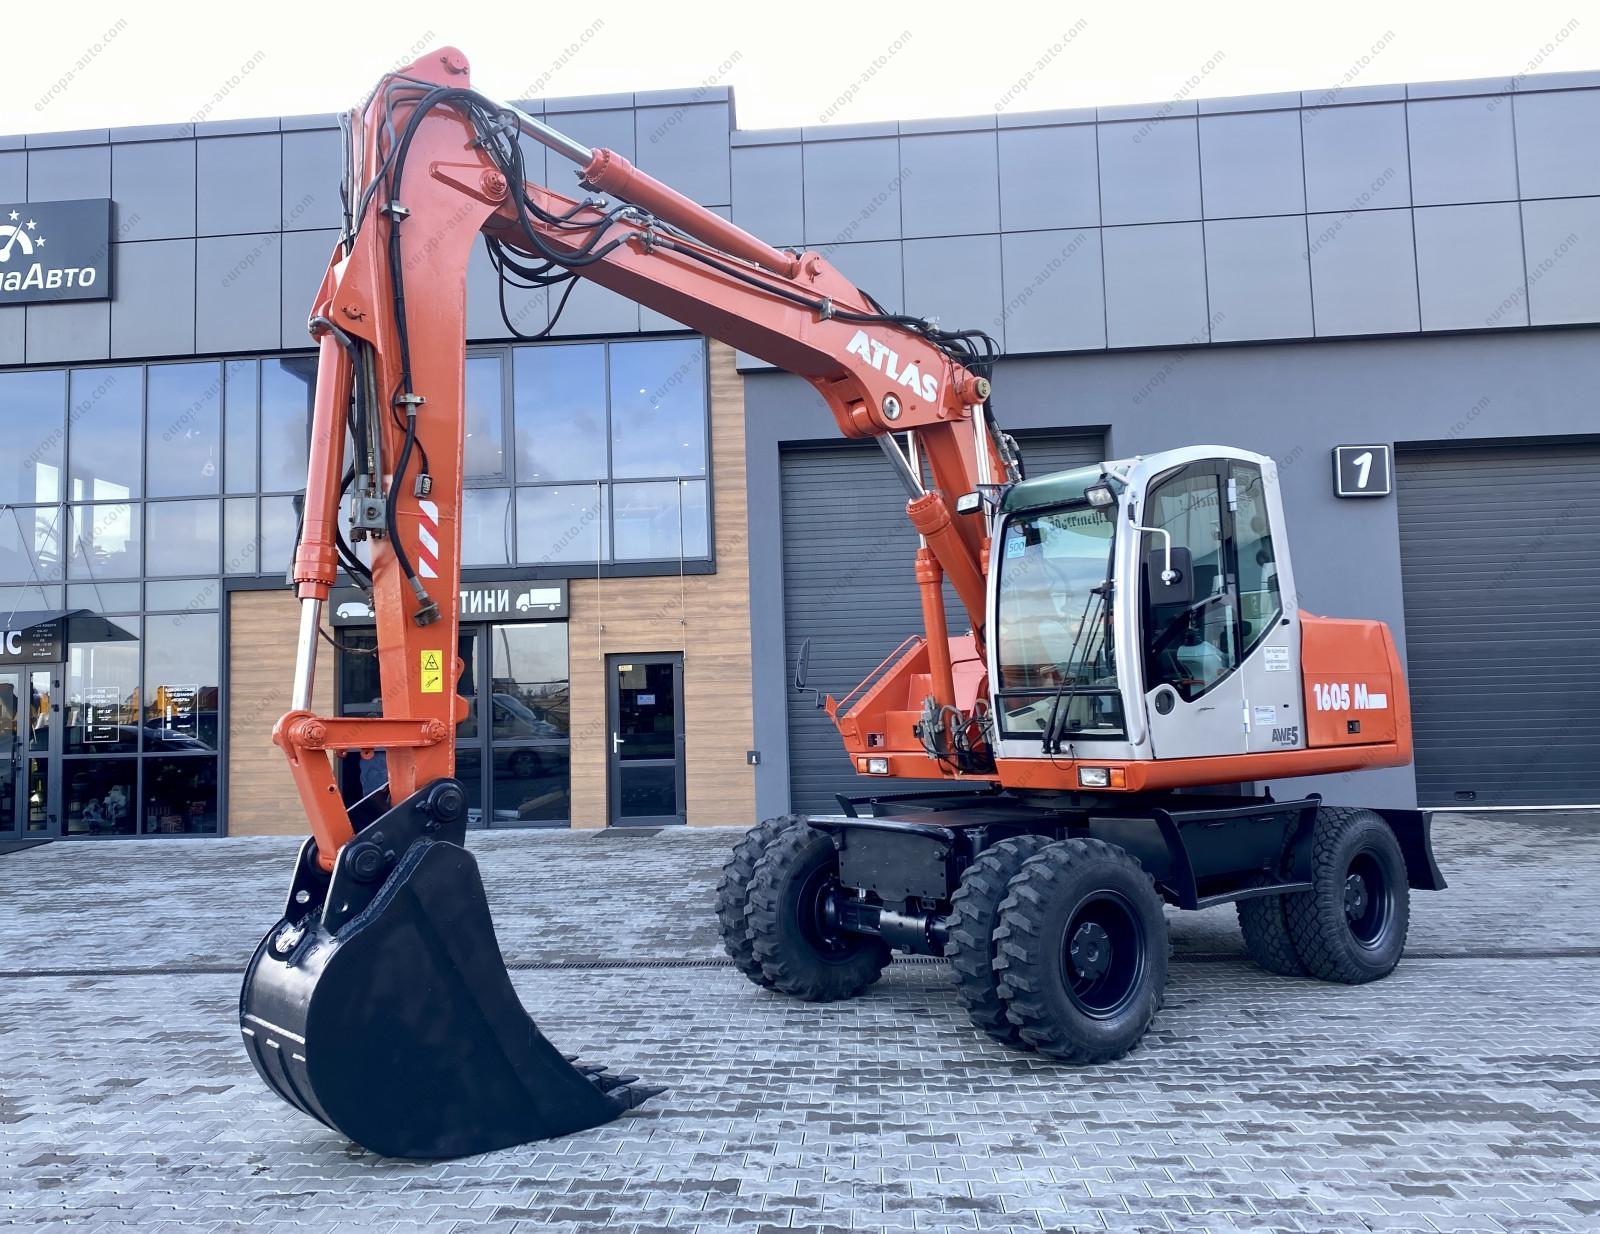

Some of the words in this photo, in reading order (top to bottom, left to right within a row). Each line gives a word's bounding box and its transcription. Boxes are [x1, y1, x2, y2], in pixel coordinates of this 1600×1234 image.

[846, 330, 938, 403] ATLAS
[1353, 451, 1373, 489] 1
[1008, 540, 1025, 552] 500
[1313, 683, 1351, 711] 1605
